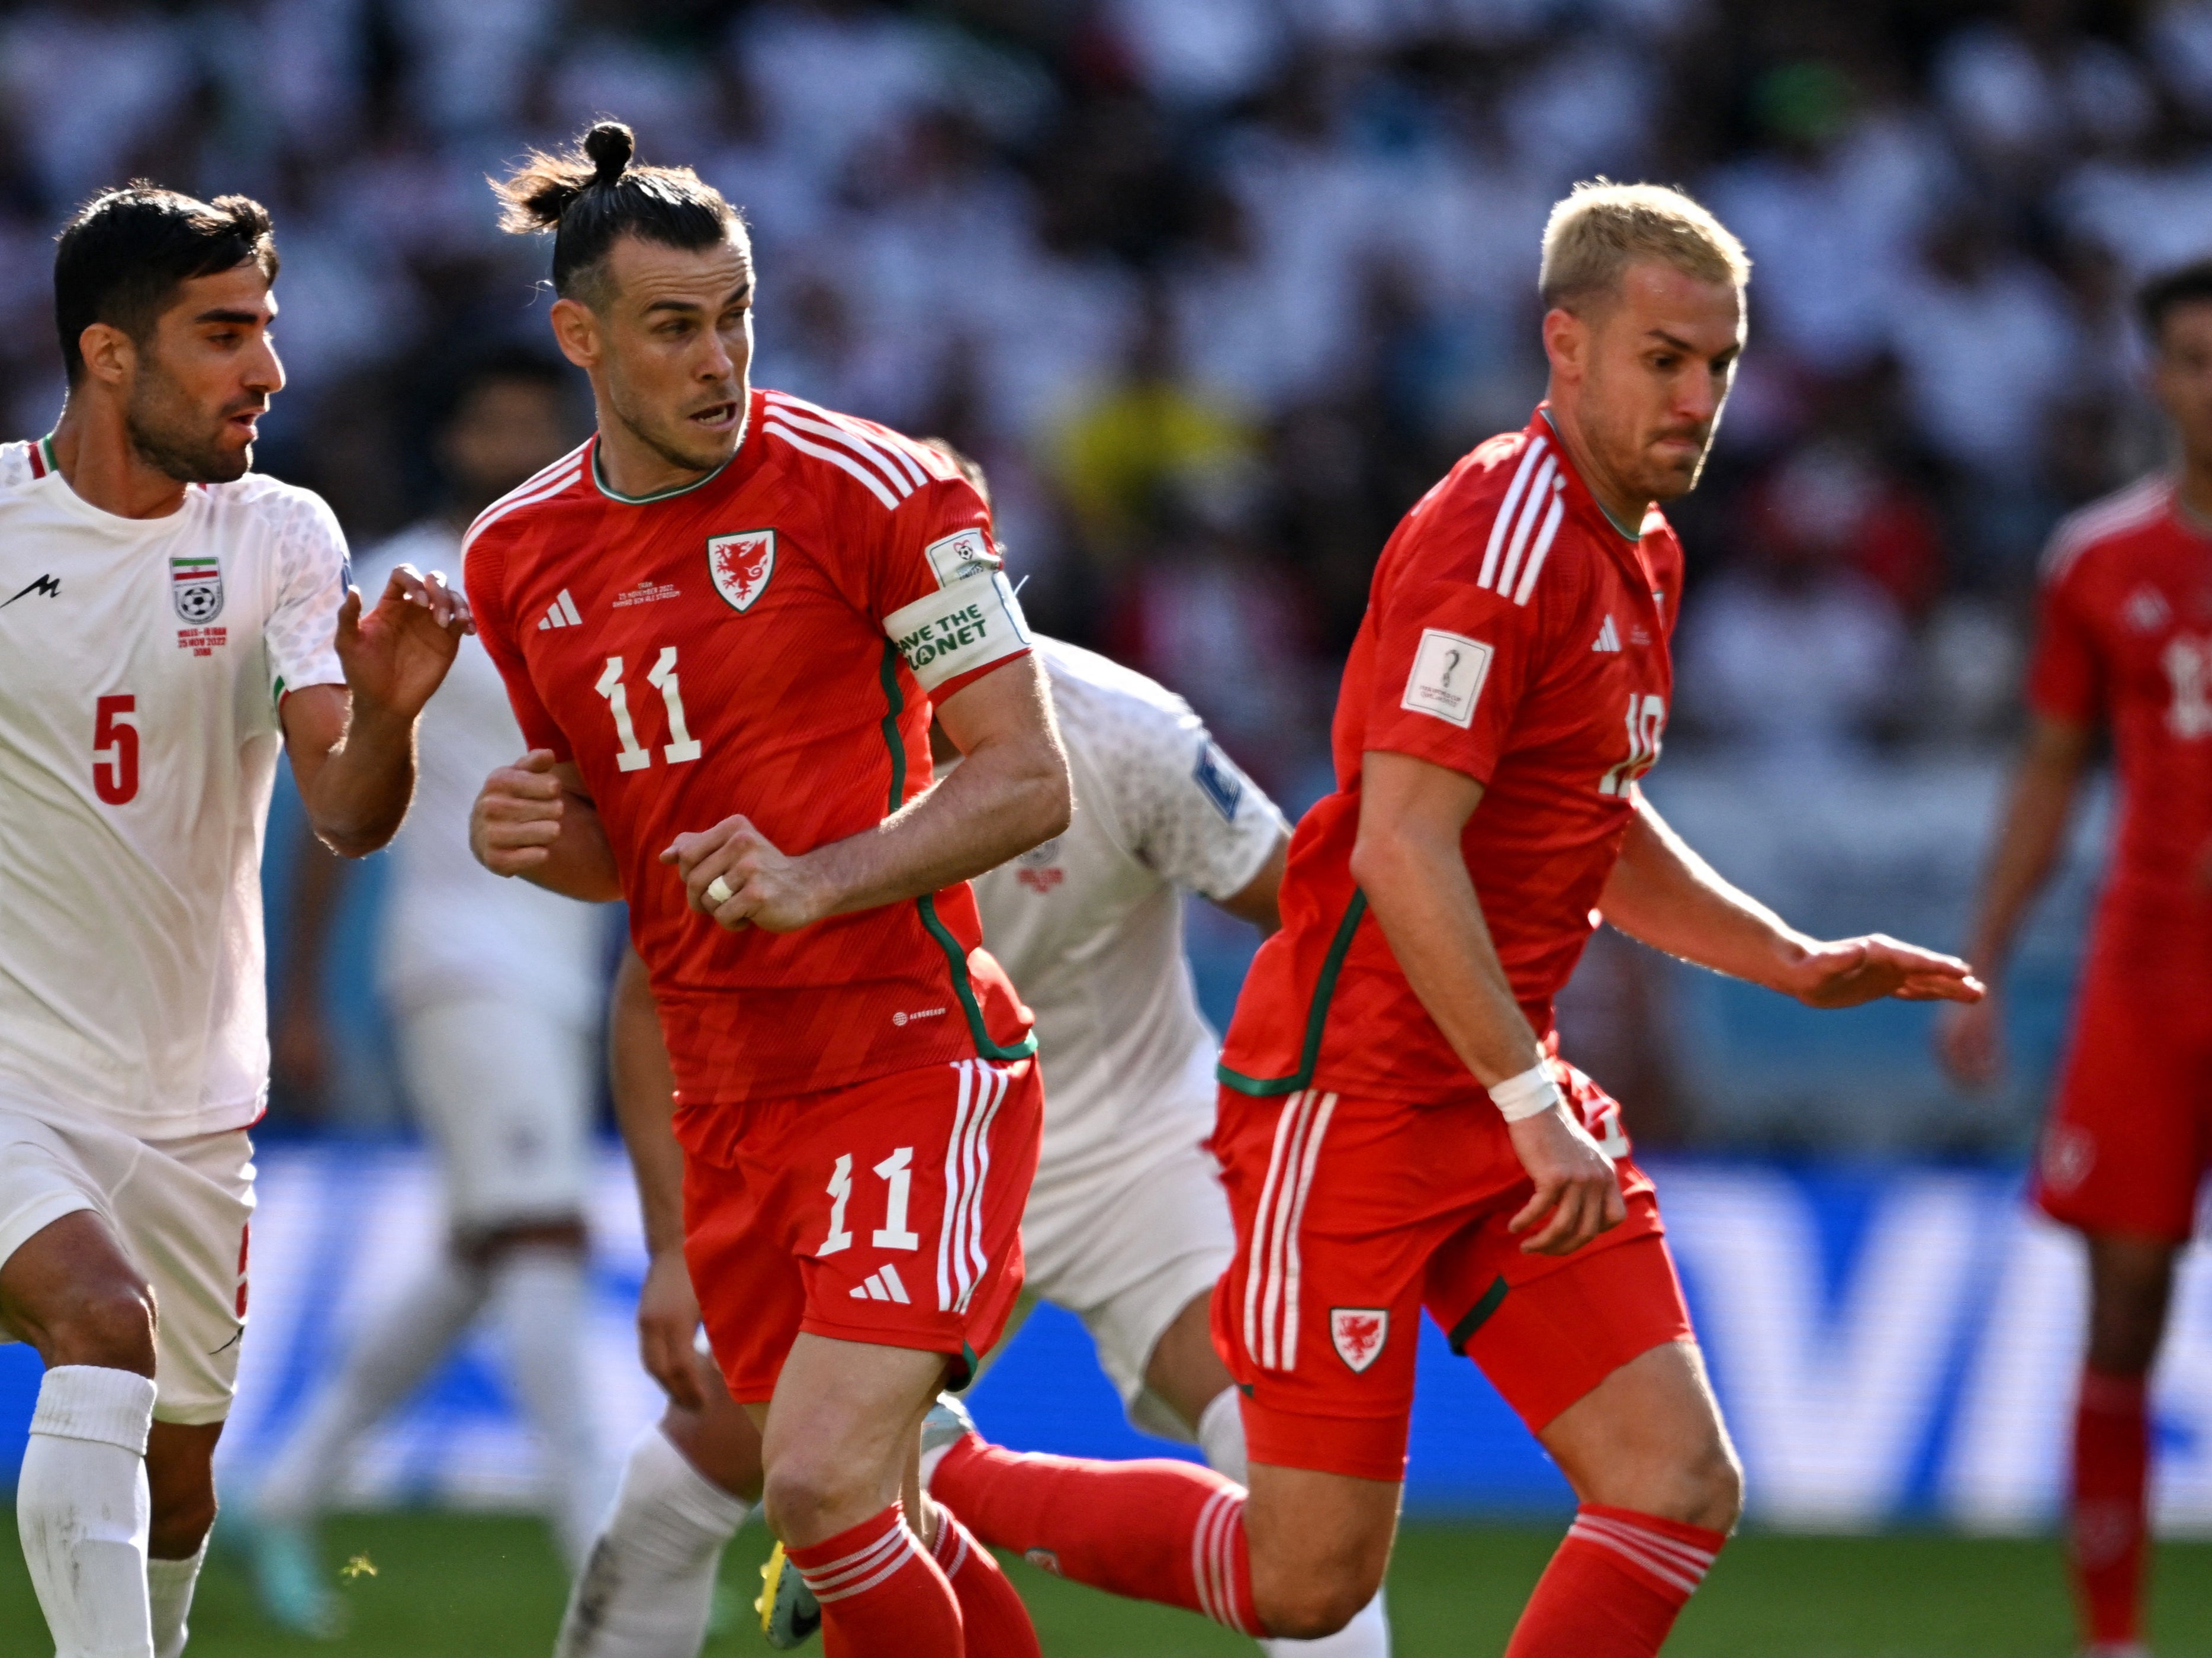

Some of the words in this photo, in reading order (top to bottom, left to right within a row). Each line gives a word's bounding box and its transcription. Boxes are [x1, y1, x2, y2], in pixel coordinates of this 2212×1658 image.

[188, 638, 205, 647] NOV
[206, 637, 226, 646] 2022
[906, 619, 986, 671] LANET
[935, 604, 982, 632] THE
[92, 694, 139, 805] 5
[594, 646, 702, 772] 11
[1599, 693, 1666, 798] 10
[815, 1147, 919, 1257] 11
